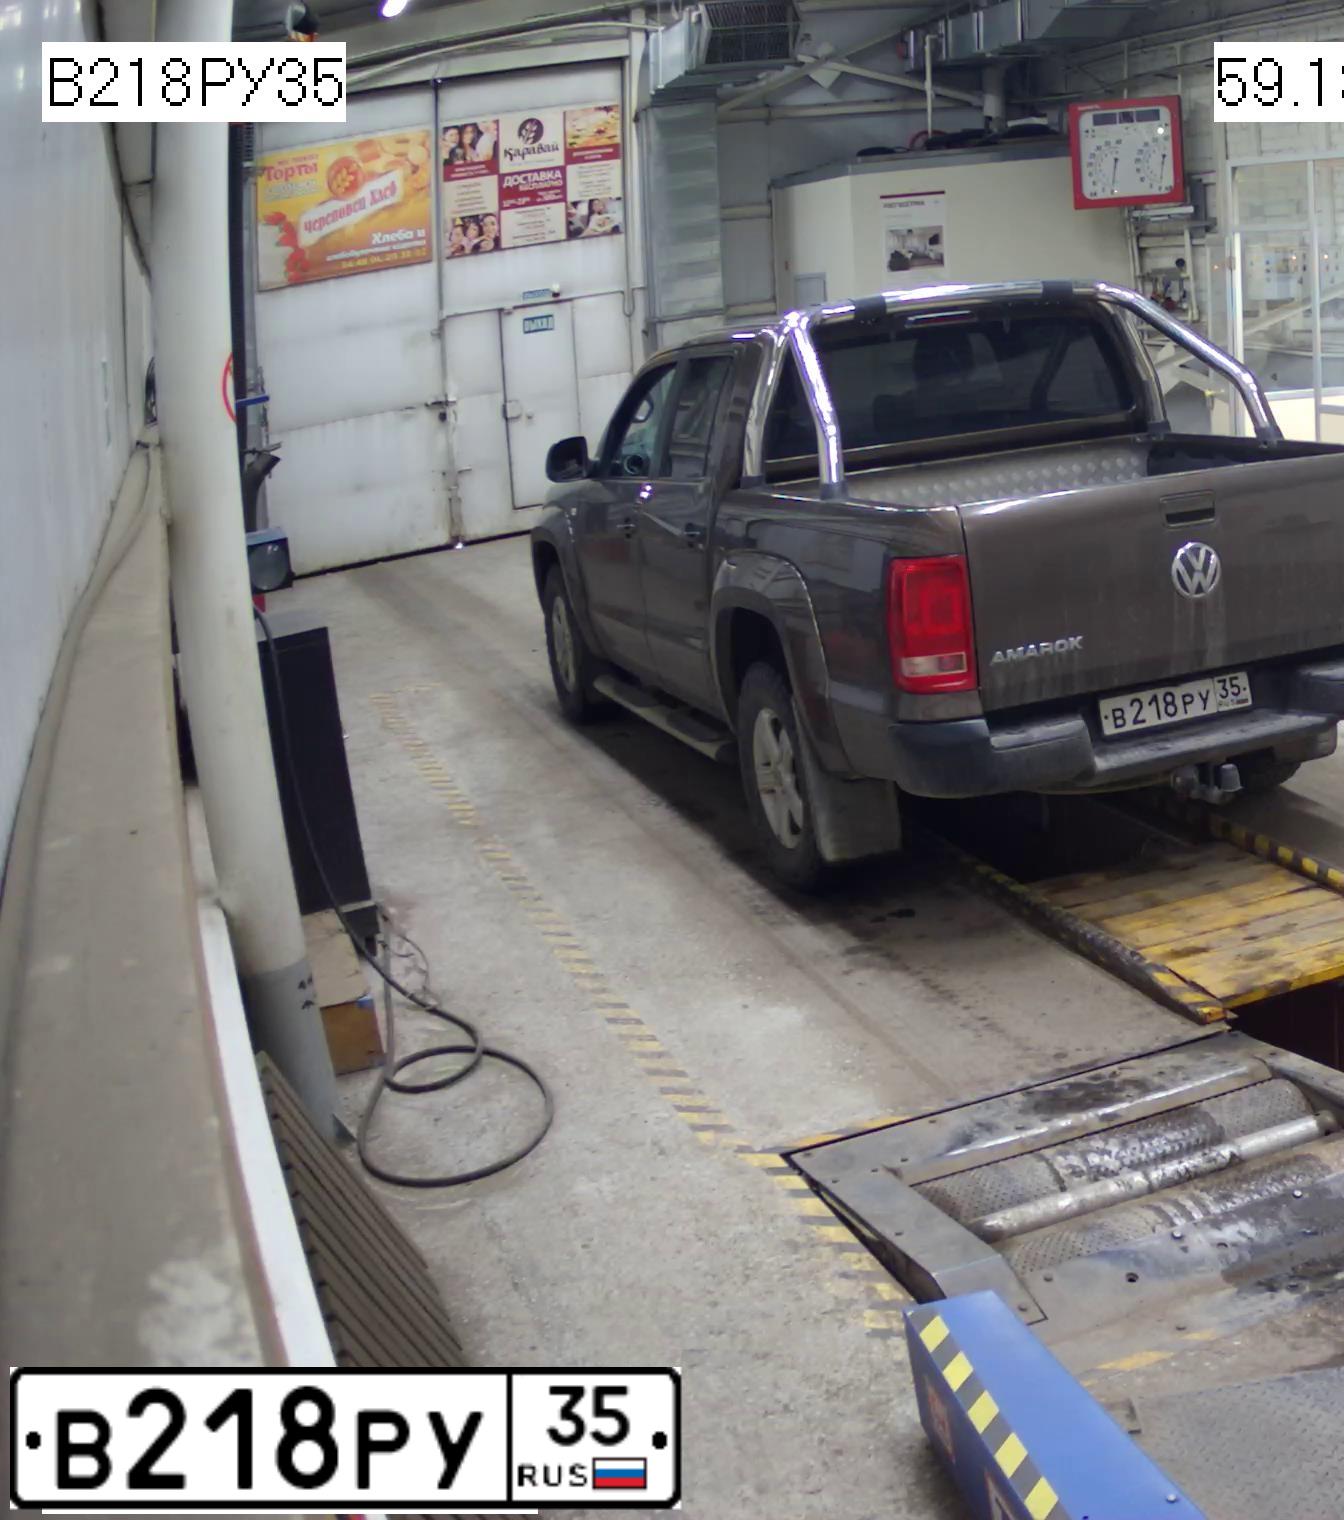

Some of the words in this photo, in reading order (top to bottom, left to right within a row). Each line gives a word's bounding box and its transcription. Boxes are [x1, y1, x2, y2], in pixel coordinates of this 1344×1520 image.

[504, 141, 560, 161] Каравай
[503, 169, 562, 188] ДОСТАВКА
[990, 636, 1083, 665] AMAROK
[1217, 676, 1240, 699] 35
